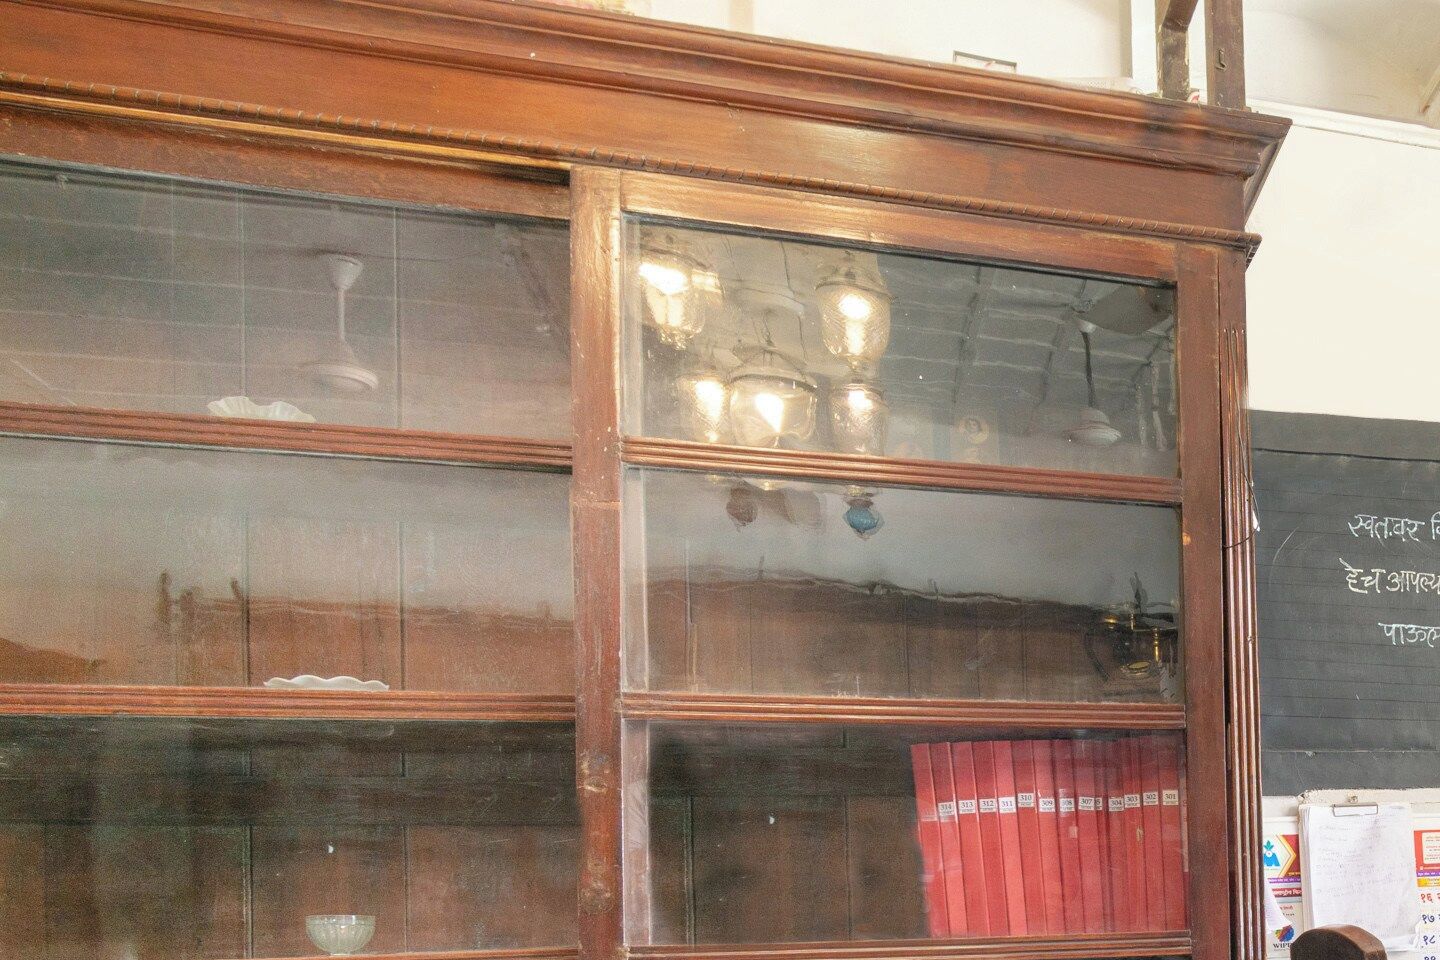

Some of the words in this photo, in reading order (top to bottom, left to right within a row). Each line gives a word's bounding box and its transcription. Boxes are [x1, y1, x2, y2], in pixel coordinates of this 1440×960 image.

[1145, 793, 1156, 801] 302
[961, 801, 973, 809] 313
[1001, 800, 1013, 808] 311
[1081, 798, 1092, 806] 307
[1420, 892, 1434, 904] १६
[1422, 914, 1435, 924] १७
[1423, 935, 1436, 945] १८
